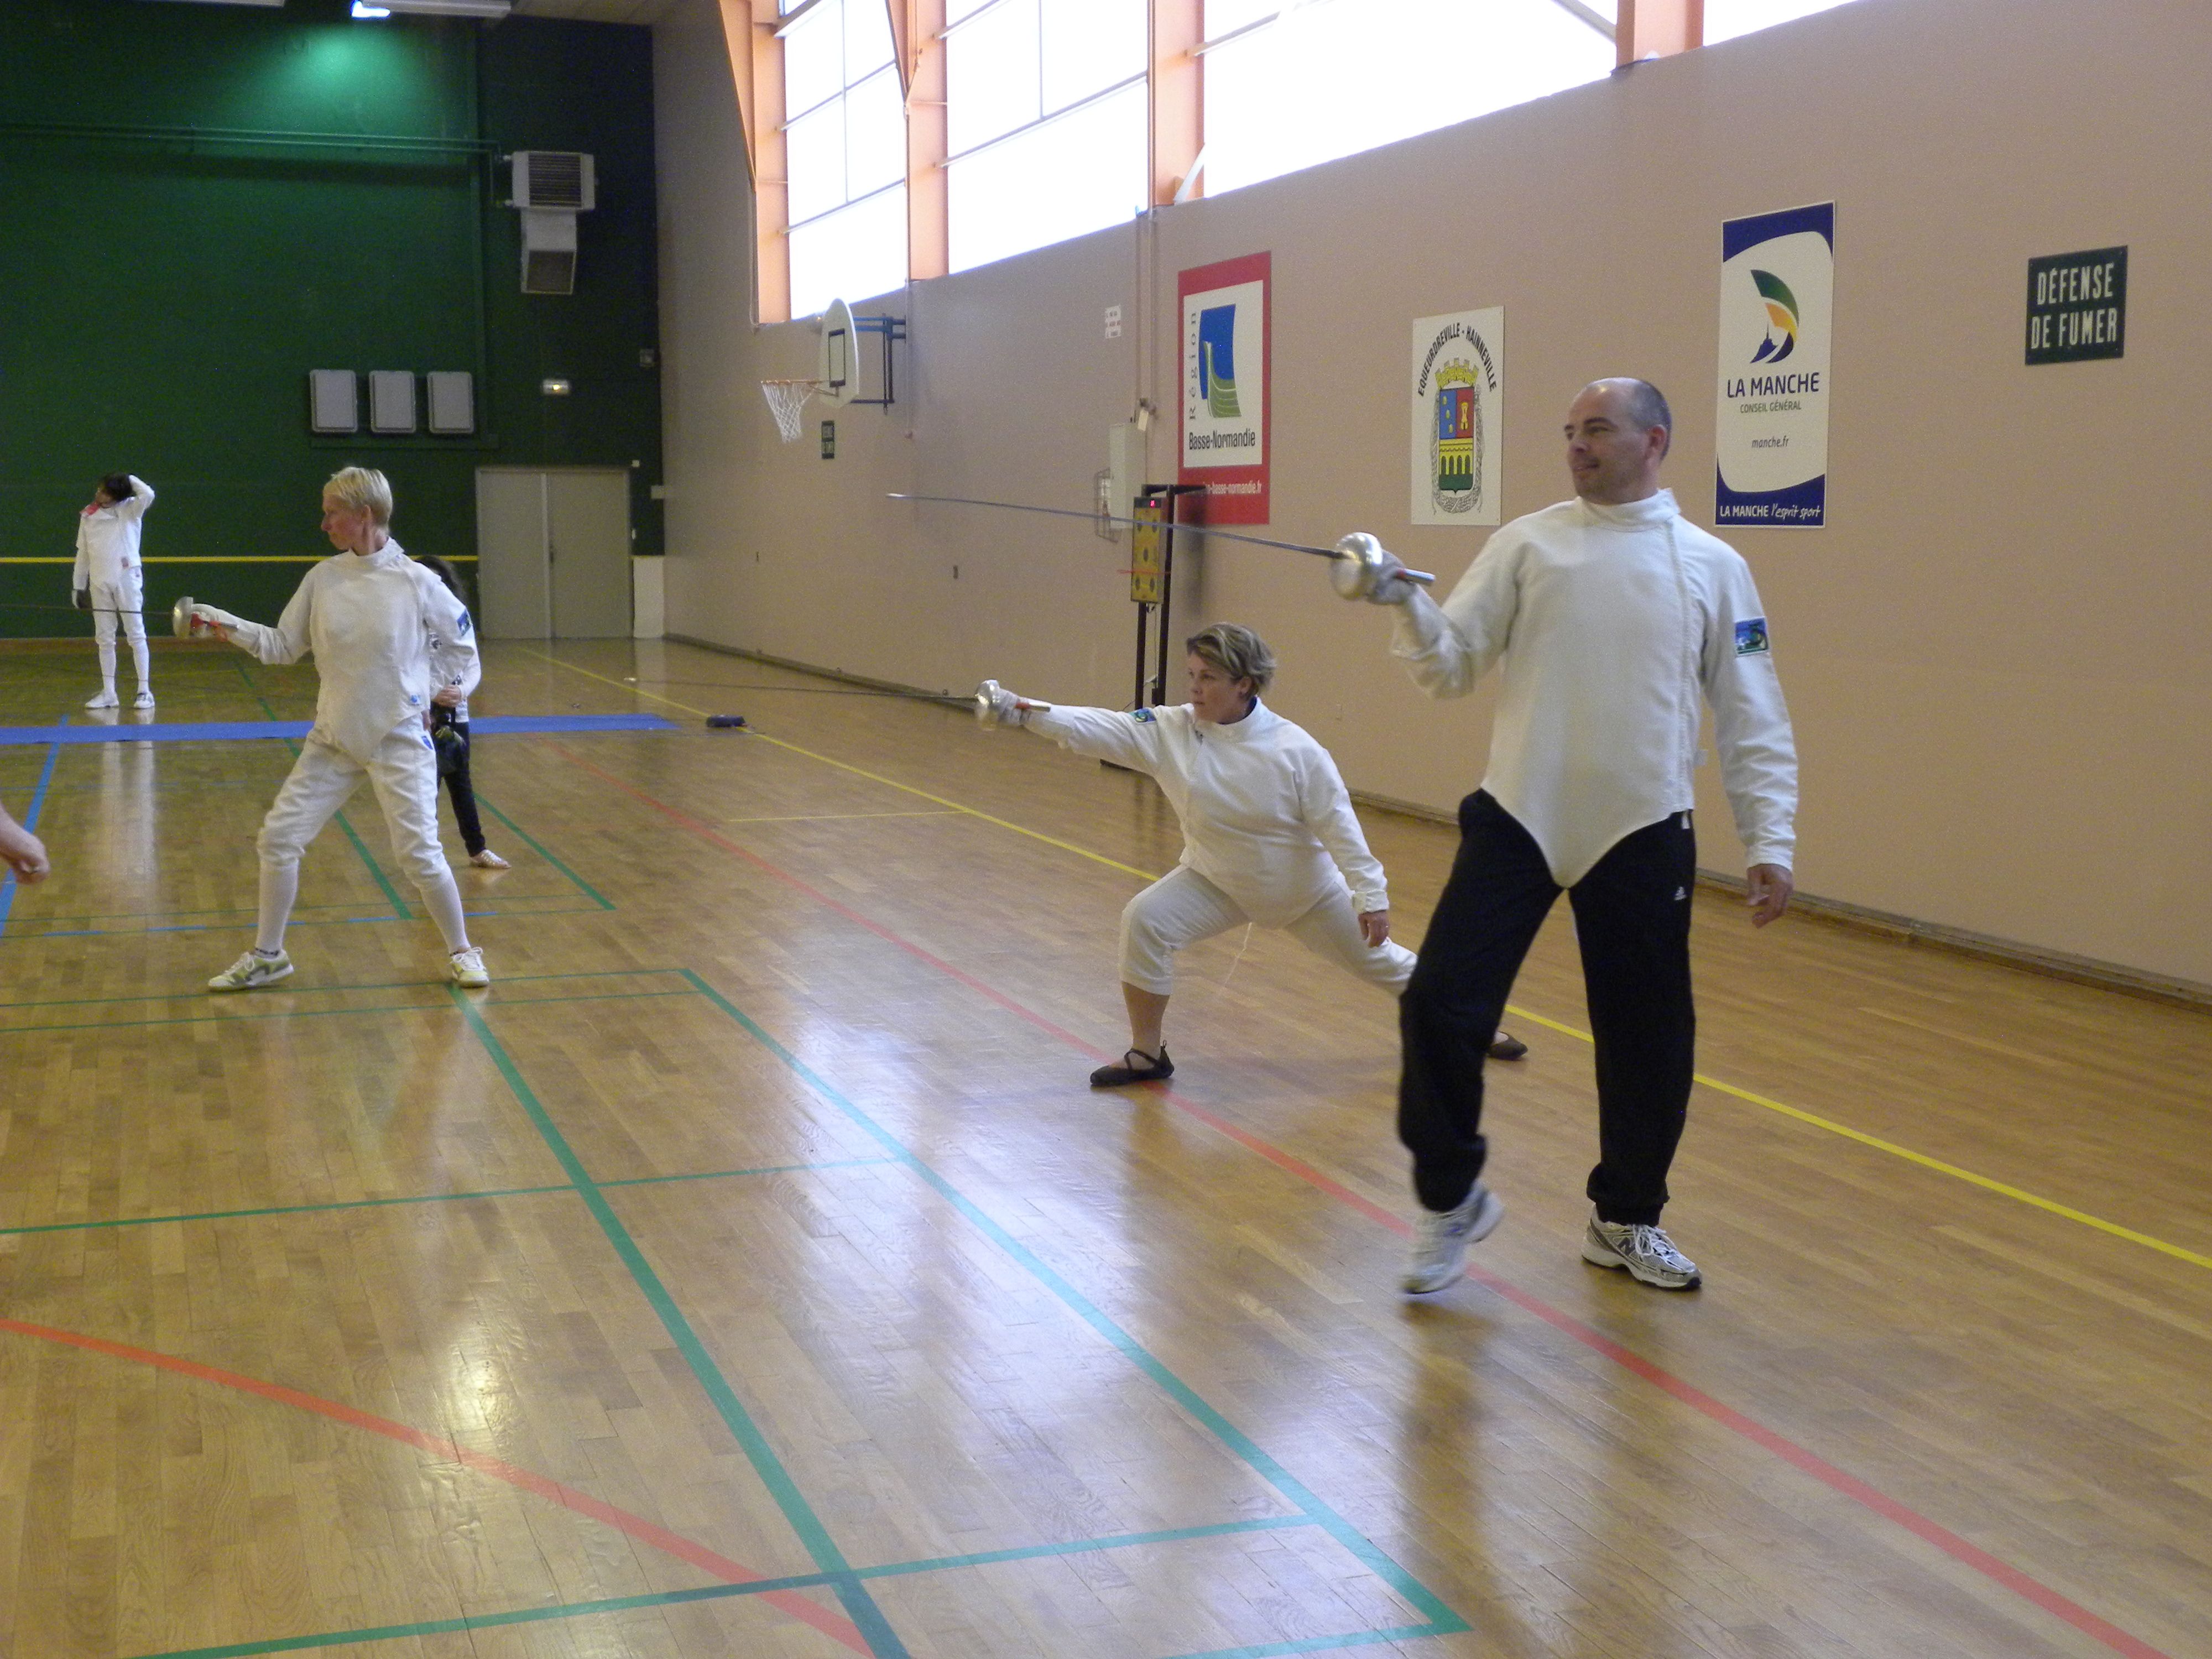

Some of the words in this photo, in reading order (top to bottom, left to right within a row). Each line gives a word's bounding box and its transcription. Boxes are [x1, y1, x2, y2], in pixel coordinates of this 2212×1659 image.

[2037, 262, 2115, 305] DÉFENSE
[2031, 315, 2052, 349] DE
[2058, 307, 2118, 347] FUMER
[1418, 322, 1460, 397] EQUEURDREVILLE
[1465, 325, 1497, 392] HAINNEVILLE
[1727, 378, 1746, 398] LA
[1750, 372, 1820, 397] MANCHE
[1740, 403, 1768, 414] CONSEIL
[1770, 399, 1802, 411] GÉNÉRAL
[1189, 427, 1256, 450] Basse-Normandie
[1751, 435, 1790, 448] manche.fr
[1720, 505, 1731, 518] LA
[1732, 505, 1770, 518] MANCHE
[1771, 503, 1799, 521] l'esprit
[1799, 504, 1821, 521] sport
